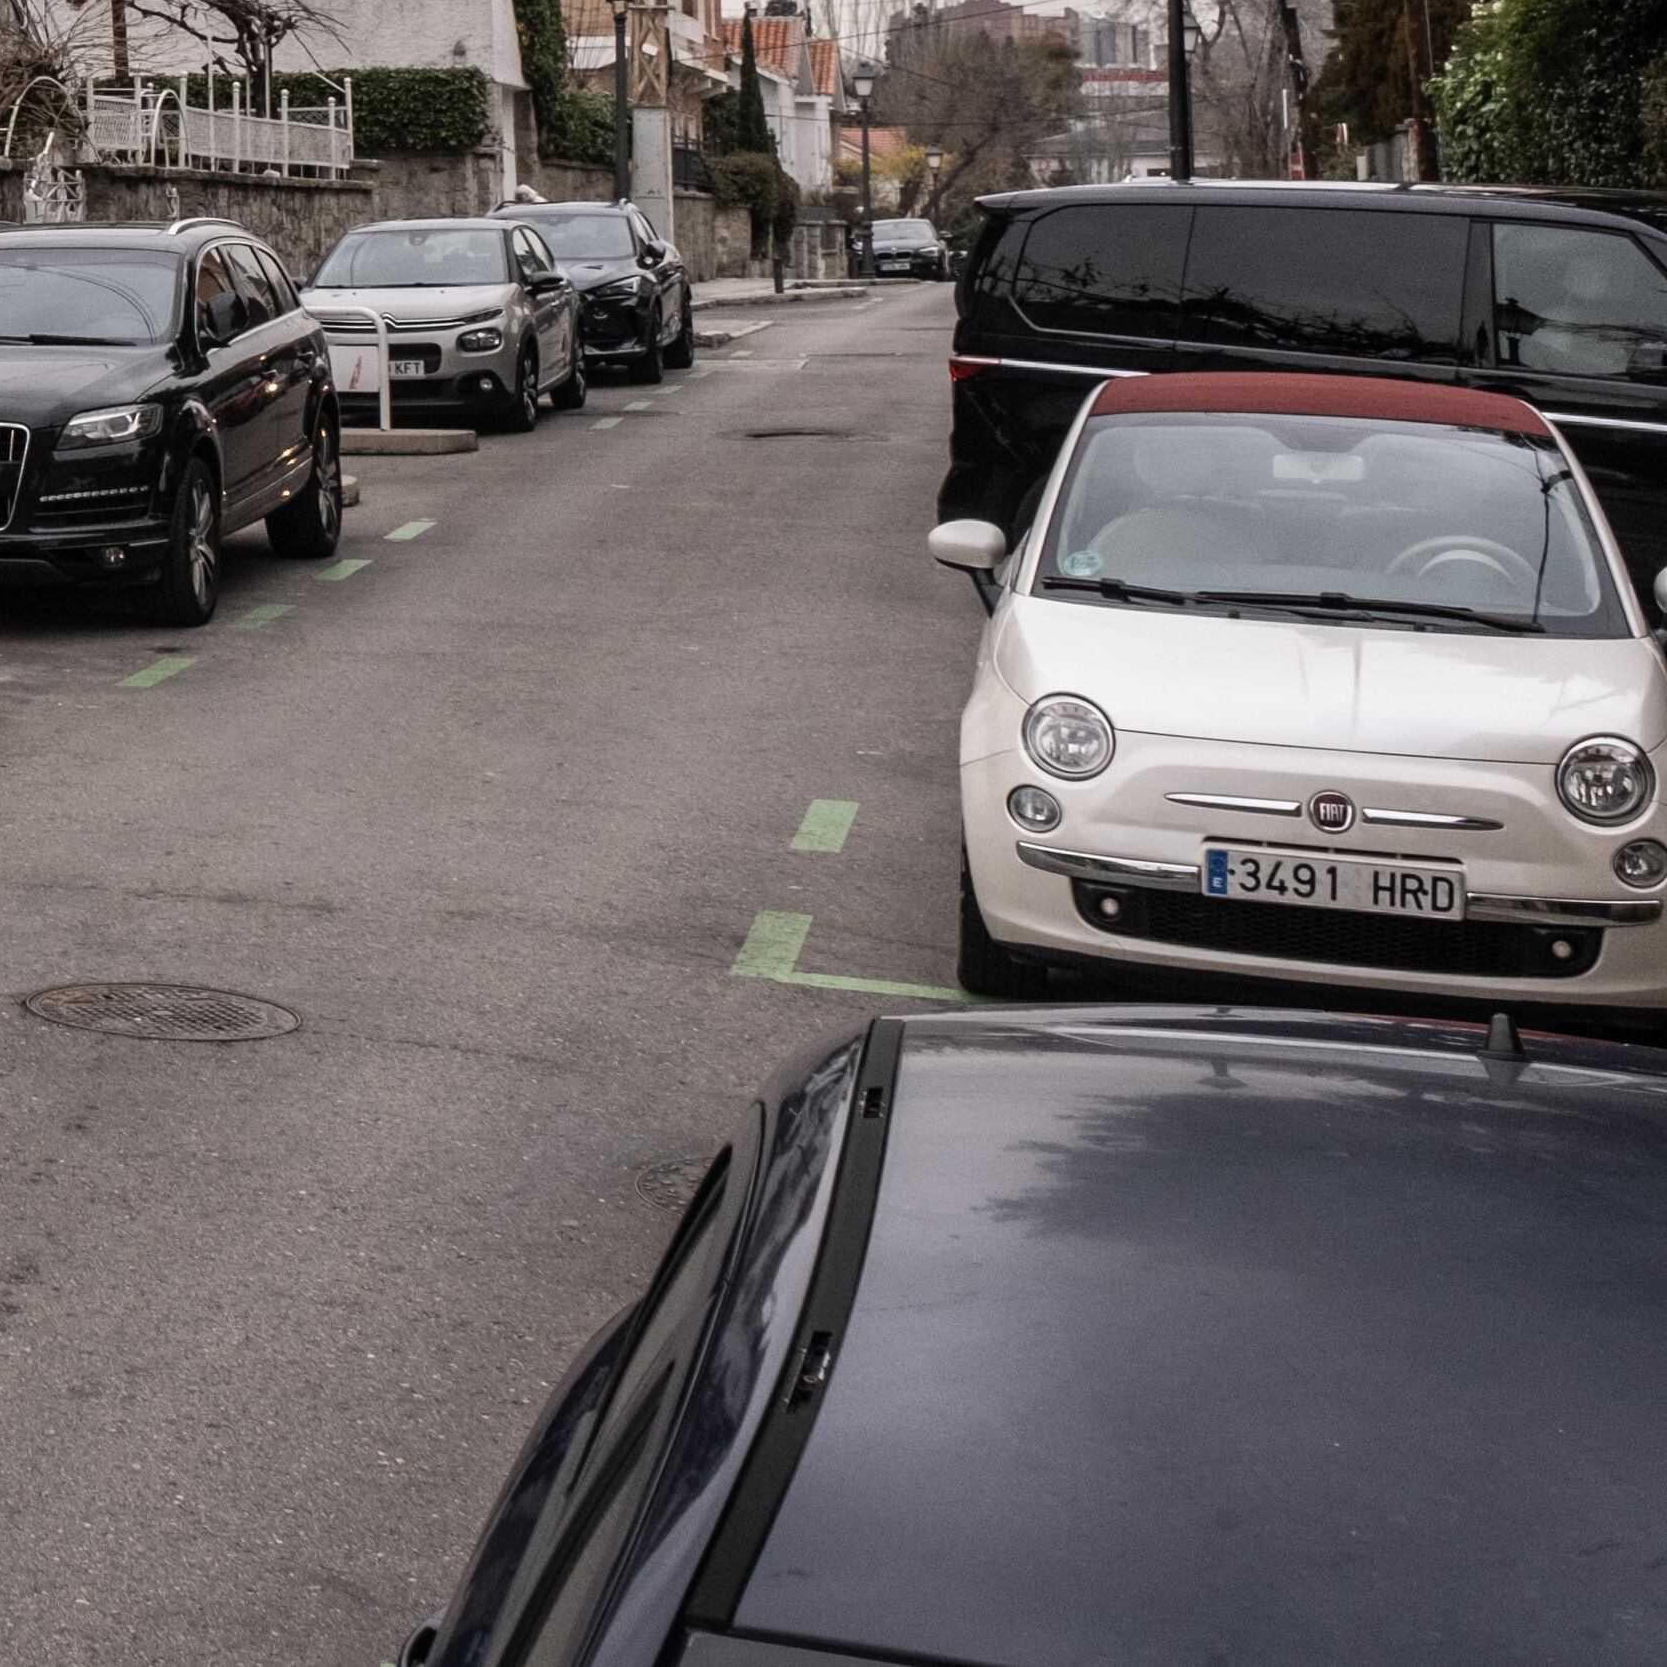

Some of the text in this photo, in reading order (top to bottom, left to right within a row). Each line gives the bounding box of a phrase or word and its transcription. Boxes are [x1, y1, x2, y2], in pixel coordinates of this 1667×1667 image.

[394, 362, 421, 375] KFT
[1319, 802, 1344, 822] FIAT
[1213, 857, 1455, 913] E 3491 HRD
